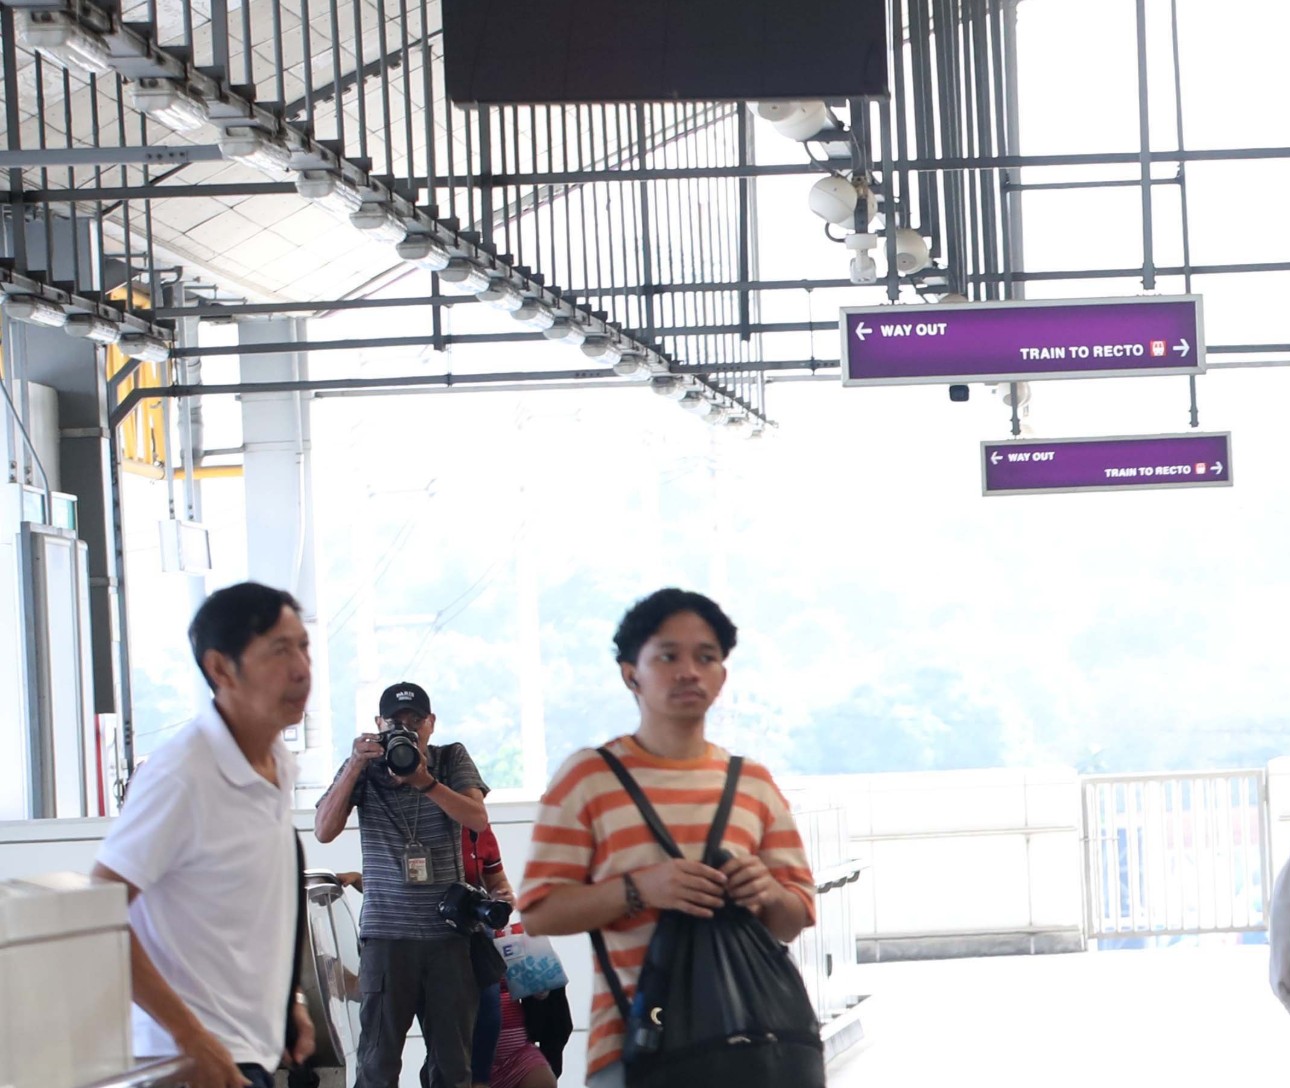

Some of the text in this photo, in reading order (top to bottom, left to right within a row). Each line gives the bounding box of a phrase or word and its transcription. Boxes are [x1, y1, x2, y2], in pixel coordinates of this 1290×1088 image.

[881, 323, 947, 338] WAY OUT
[1020, 344, 1144, 361] TRAIN TO RECTO
[1008, 451, 1055, 463] WAY OUT
[1104, 465, 1191, 478] TRAIN TO RECTO
